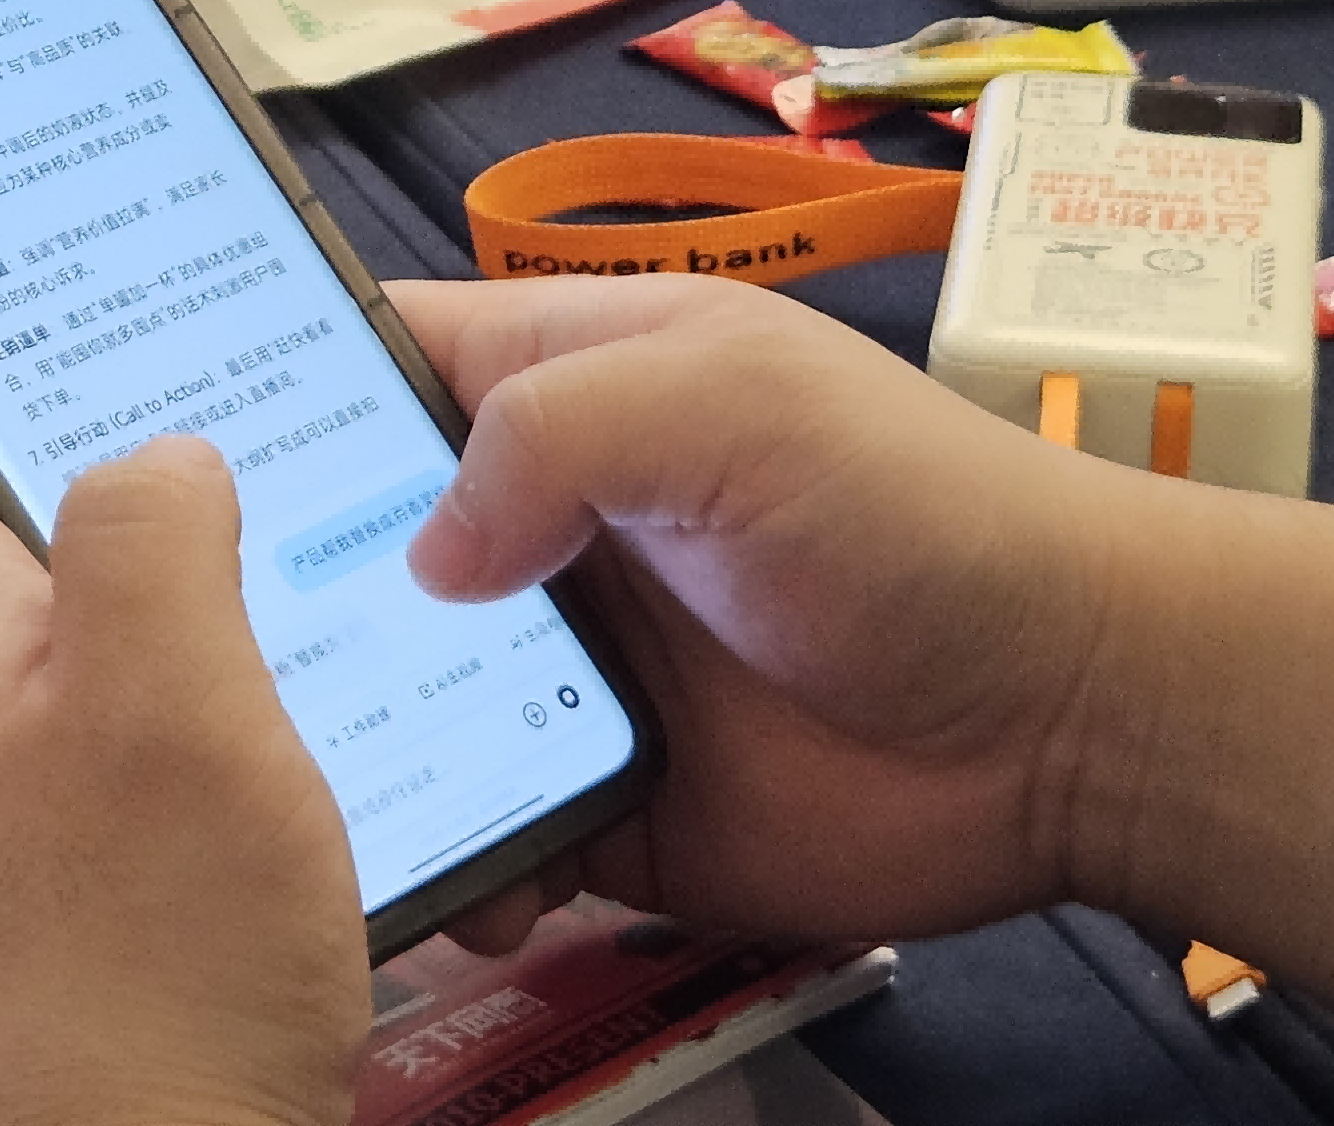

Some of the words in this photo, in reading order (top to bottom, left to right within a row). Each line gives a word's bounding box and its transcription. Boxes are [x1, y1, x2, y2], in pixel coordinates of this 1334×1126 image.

[503, 247, 667, 276] power
[686, 229, 816, 275] bank
[142, 398, 164, 416] to
